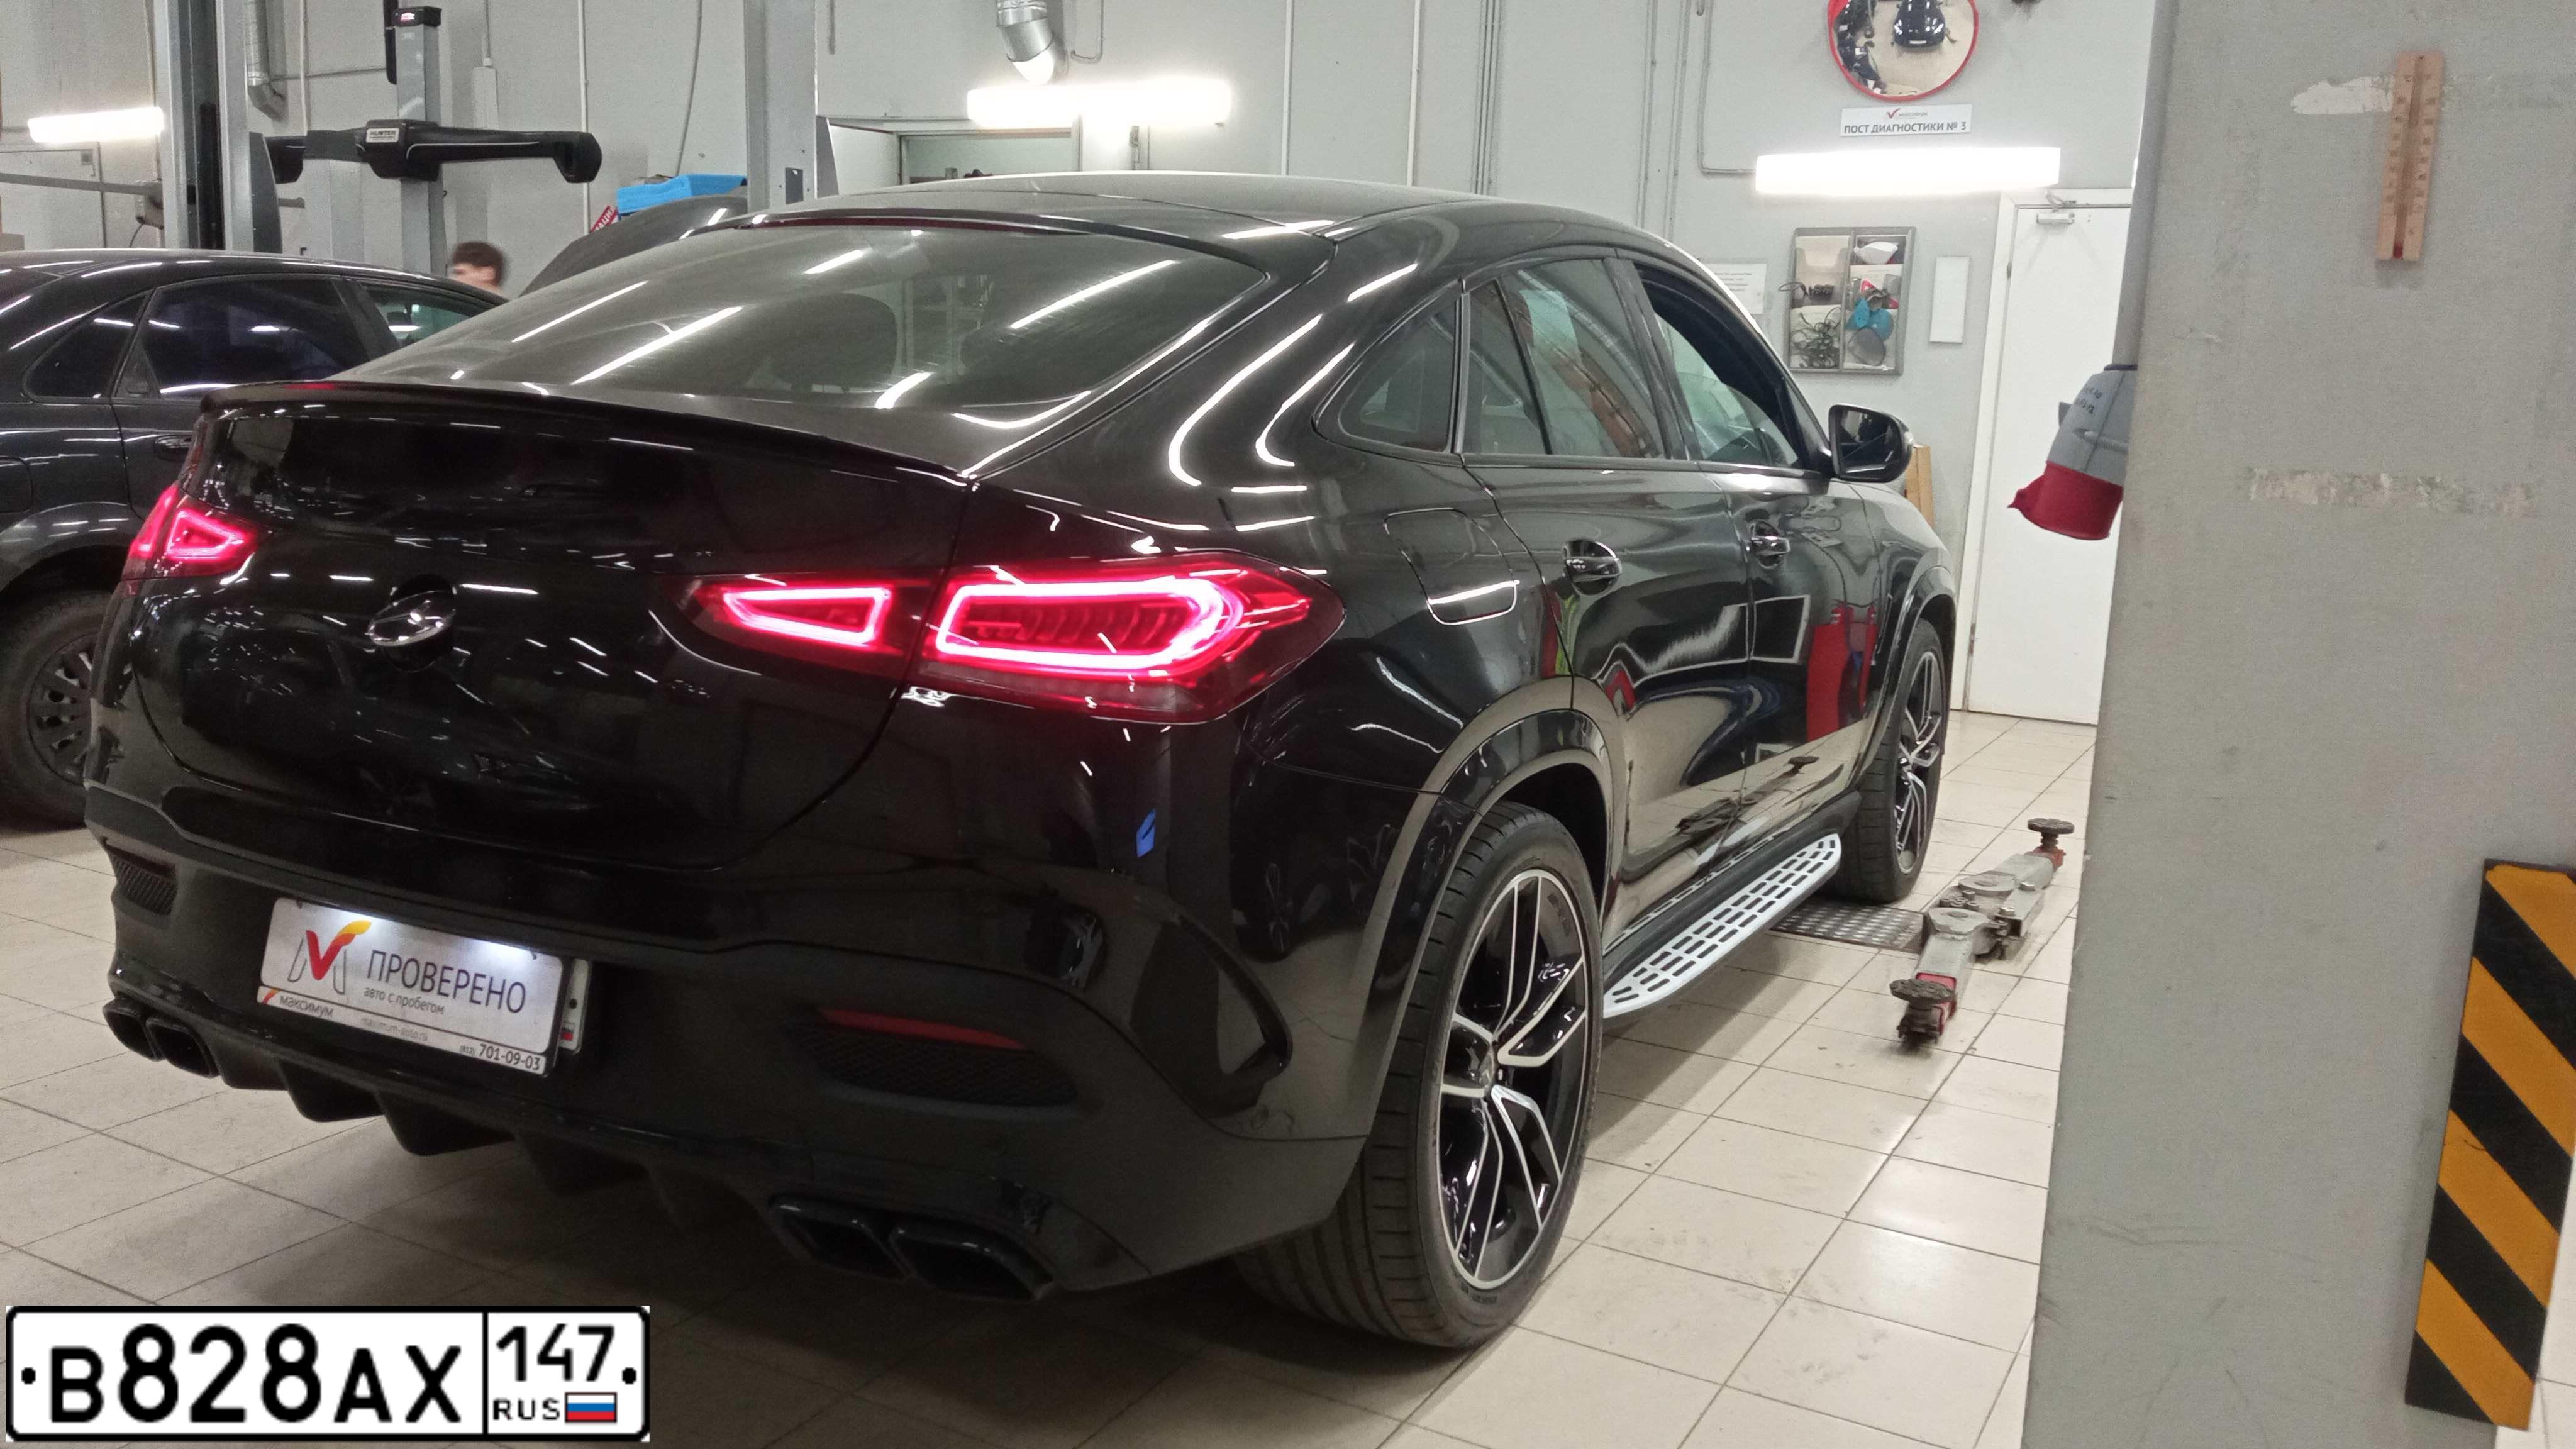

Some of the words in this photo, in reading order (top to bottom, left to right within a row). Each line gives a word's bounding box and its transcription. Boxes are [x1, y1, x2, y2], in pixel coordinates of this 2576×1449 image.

[1844, 125, 1870, 134] ПОСТ
[1870, 121, 1945, 134] ДИАГНОСТИКИ
[1946, 122, 1958, 131] №
[1960, 121, 1967, 131] 3
[367, 950, 526, 1014] ПРОВЕРЕНО
[279, 995, 335, 1018] максимум
[363, 987, 386, 1001] авто
[387, 994, 395, 1002] с
[396, 993, 445, 1016] пробегом
[479, 1043, 541, 1070] 701-09-03
